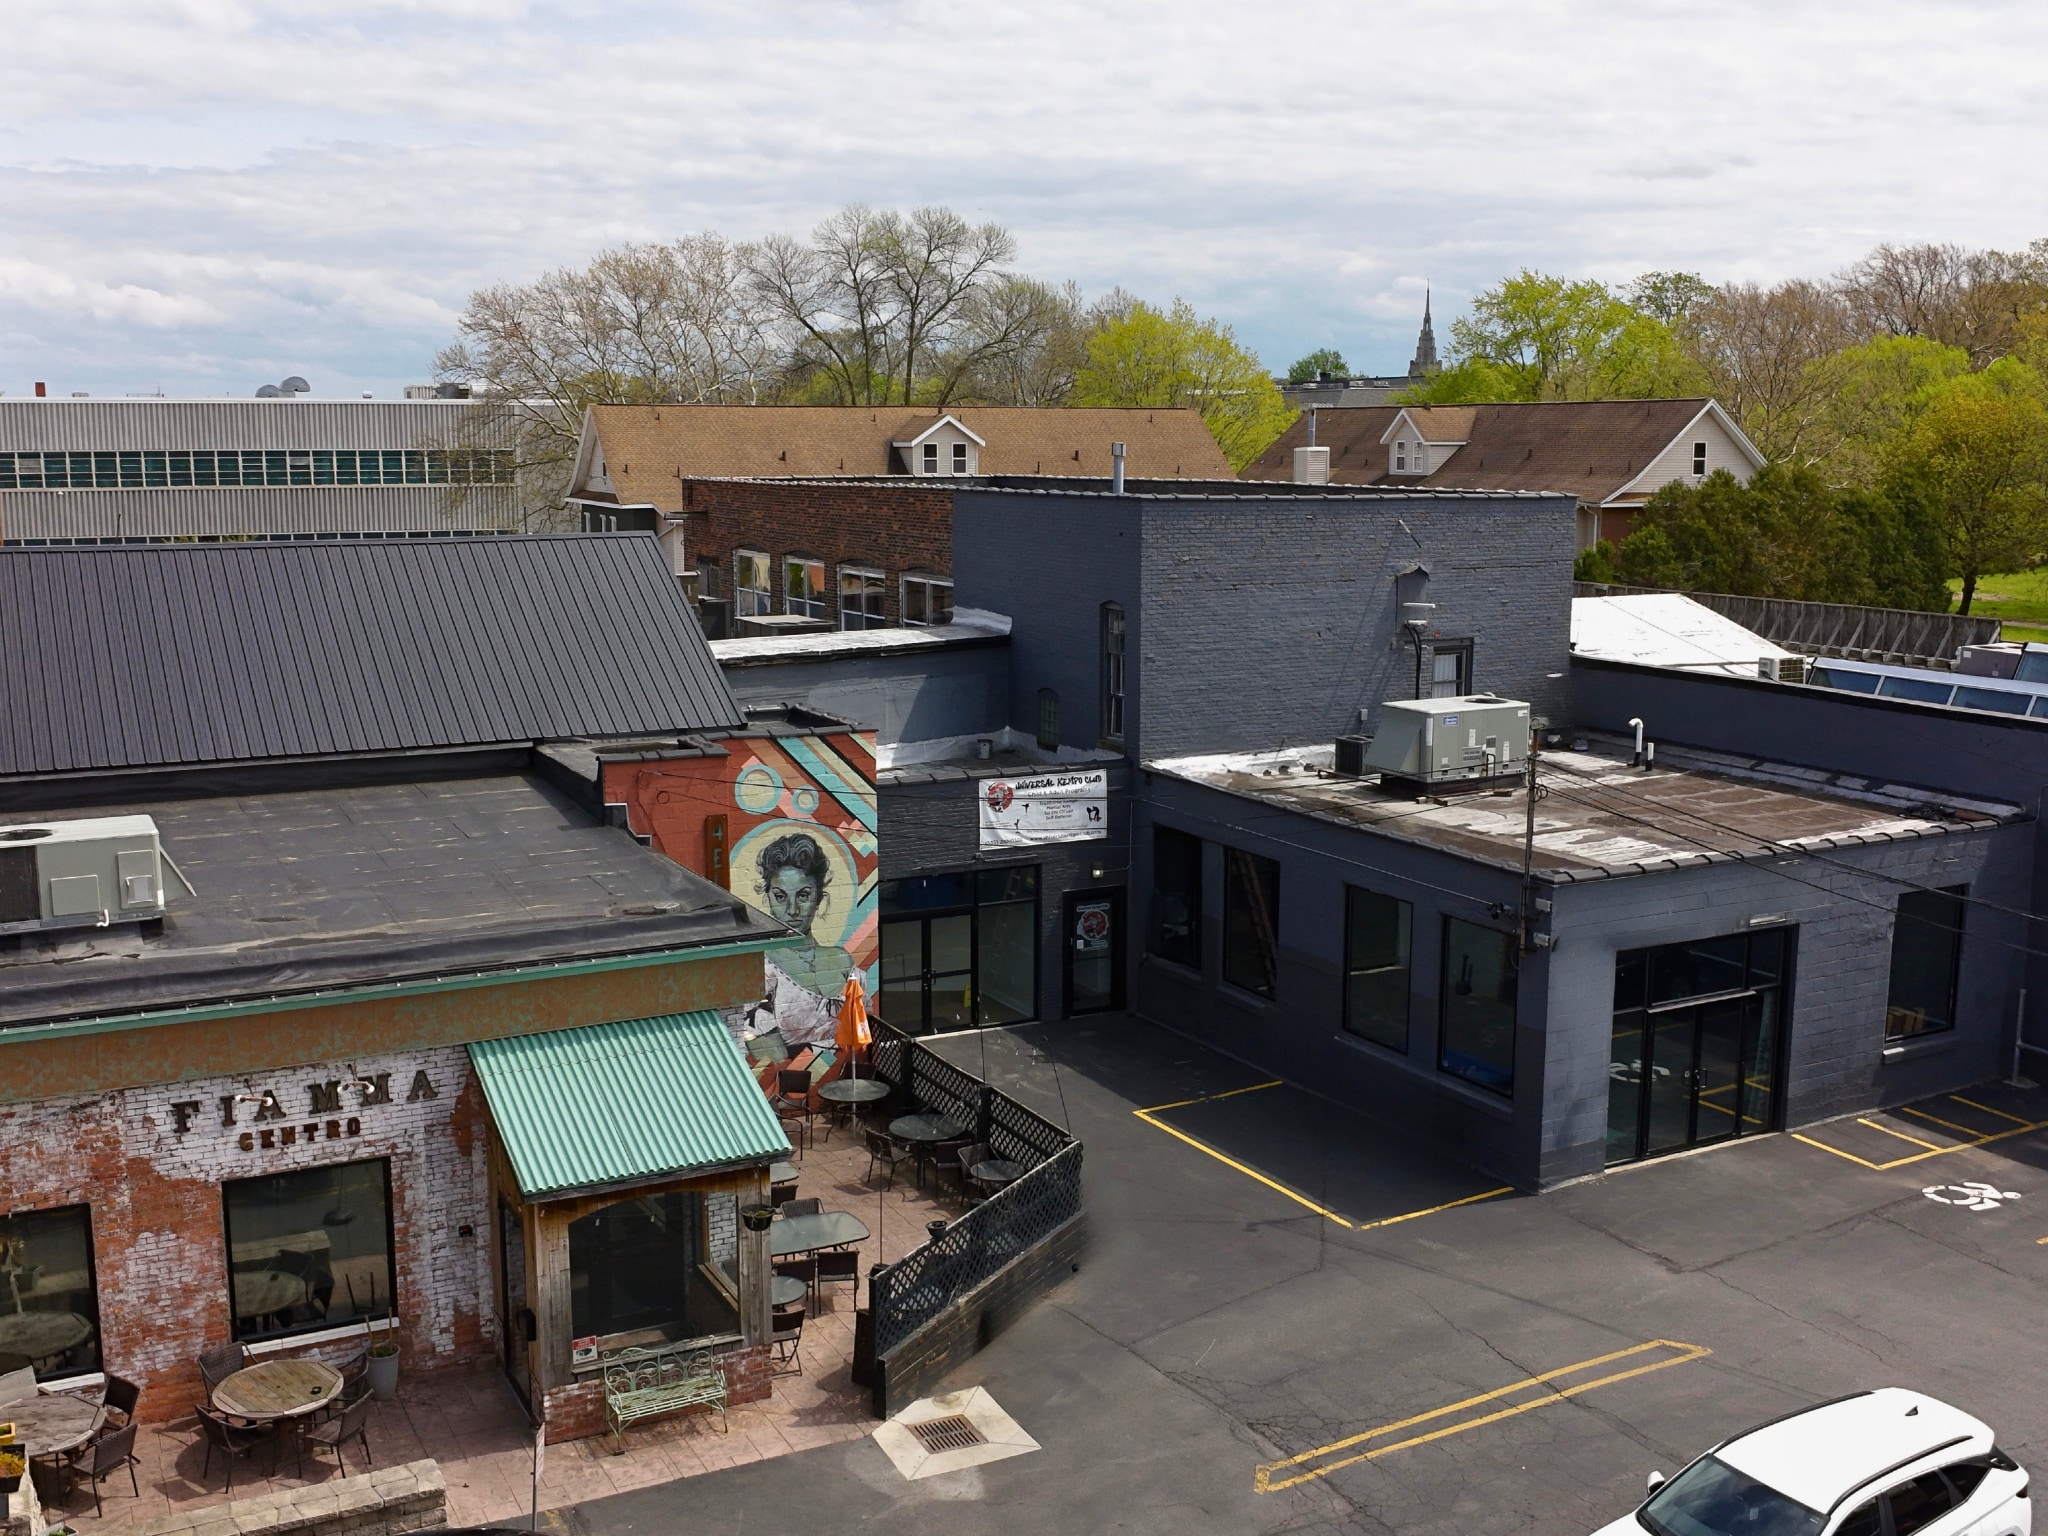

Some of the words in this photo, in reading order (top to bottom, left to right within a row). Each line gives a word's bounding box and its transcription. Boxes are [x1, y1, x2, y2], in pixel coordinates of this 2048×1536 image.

[1015, 778, 1055, 790] UNIVERSAL
[1057, 775, 1083, 787] KEMPO
[1084, 774, 1102, 784] CLUB
[171, 1069, 439, 1134] FIAMMA
[238, 1117, 362, 1151] CENTRO
